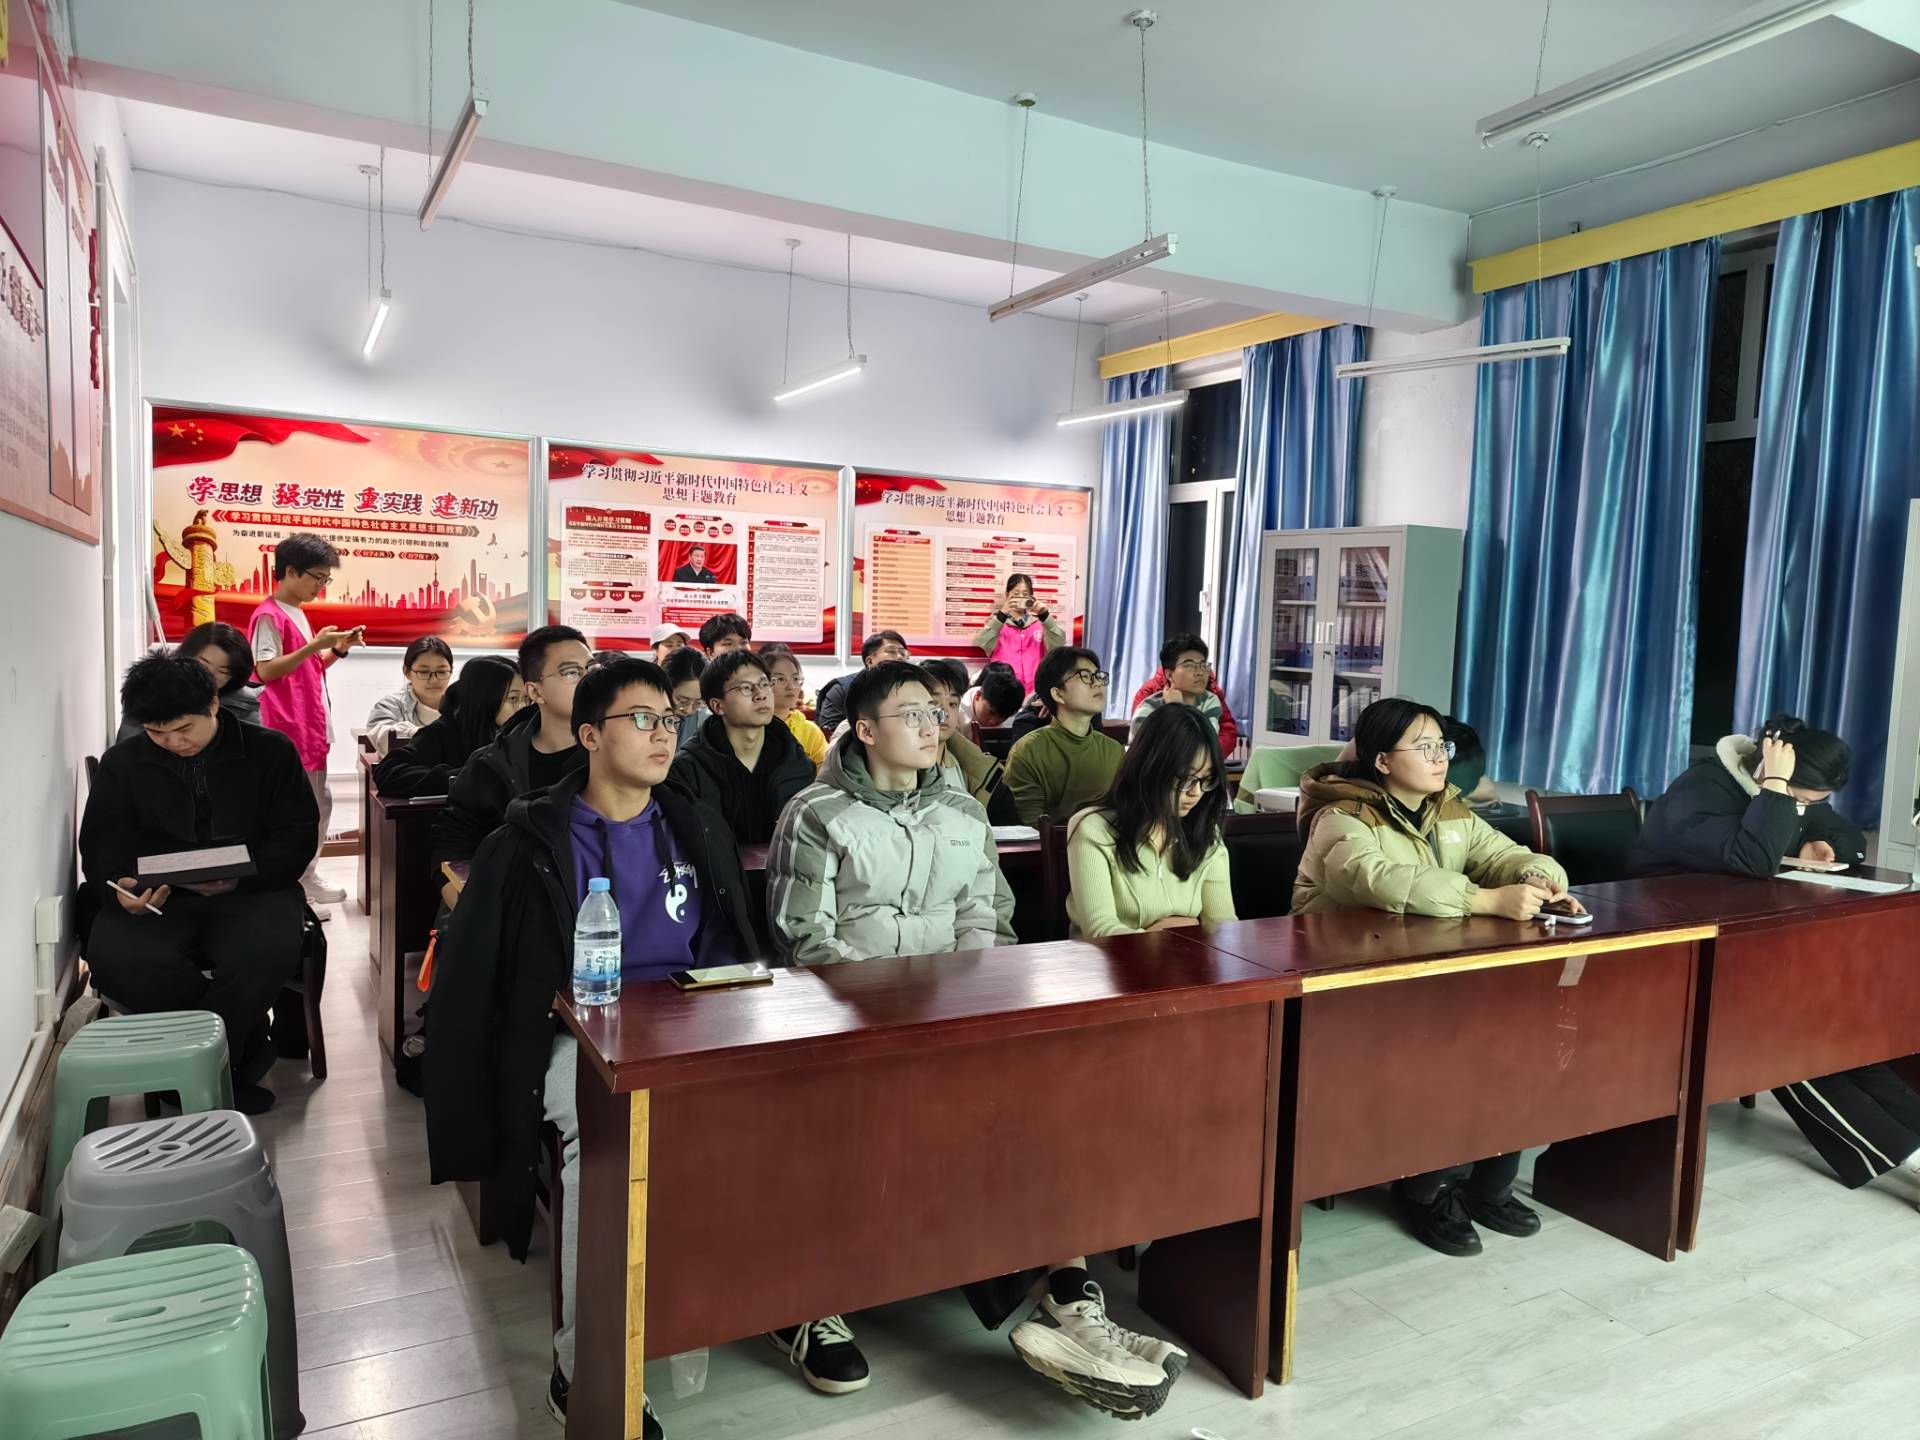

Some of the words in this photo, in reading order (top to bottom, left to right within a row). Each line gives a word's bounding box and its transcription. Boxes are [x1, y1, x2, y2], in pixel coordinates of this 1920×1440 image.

[582, 464, 808, 496] 学习贯彻习近平新时代中国特色社会主义
[187, 475, 263, 505] 学思想
[273, 482, 345, 511] 强党性
[355, 486, 423, 514] 重实践
[431, 492, 499, 520] 建新功
[662, 487, 736, 506] 思想主题教育
[882, 491, 1063, 516] 学习贯彻习近平新时代中国特色社会主义
[231, 511, 463, 535] 学习贯彻习近平新时代中国特色社会主义思想主题教育
[945, 510, 1005, 526] 思想主题教育
